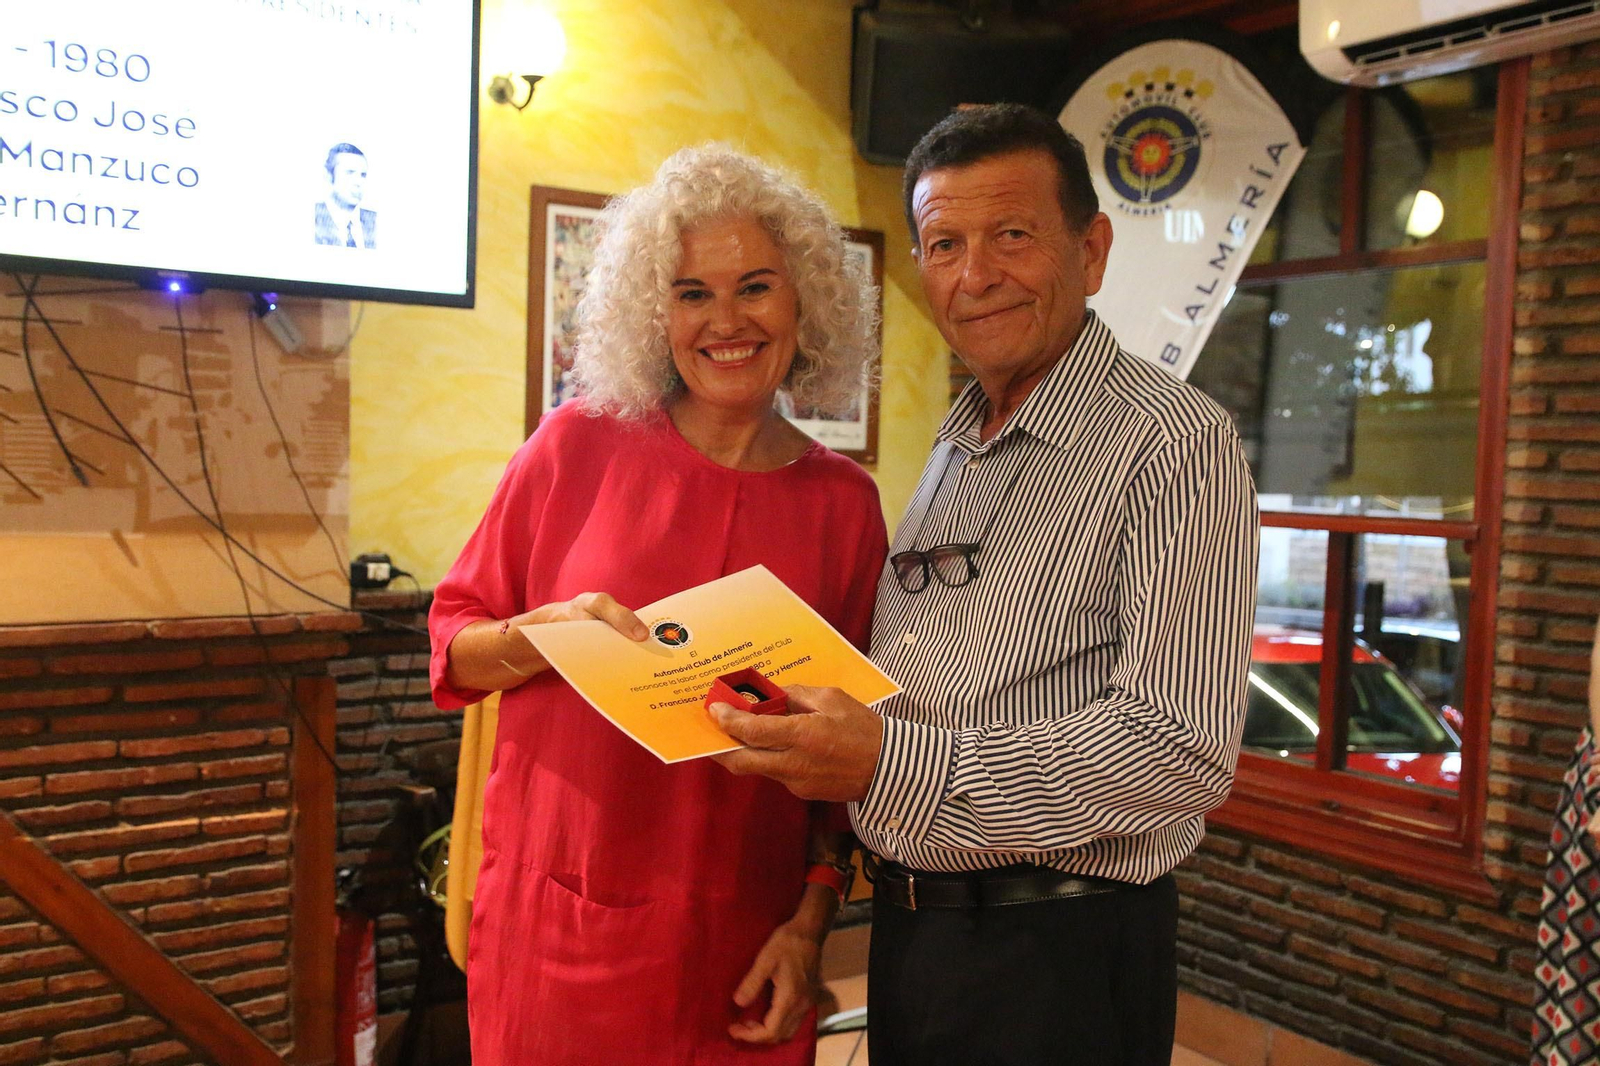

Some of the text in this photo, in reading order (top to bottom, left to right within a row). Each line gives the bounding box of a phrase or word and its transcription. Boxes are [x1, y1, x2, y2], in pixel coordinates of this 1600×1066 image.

[43, 40, 151, 83] 1980
[93, 100, 197, 139] José
[0, 136, 200, 188] Manzuco
[1184, 140, 1290, 325] ALMERÍA
[629, 637, 793, 693] reconoce la labor como presidente del Club
[653, 641, 753, 678] Automóvil Club de Almería
[689, 650, 698, 658] El
[658, 696, 698, 708] Francisco
[774, 668, 780, 676] y
[779, 655, 812, 672] Hernánz
[684, 685, 692, 693] el
